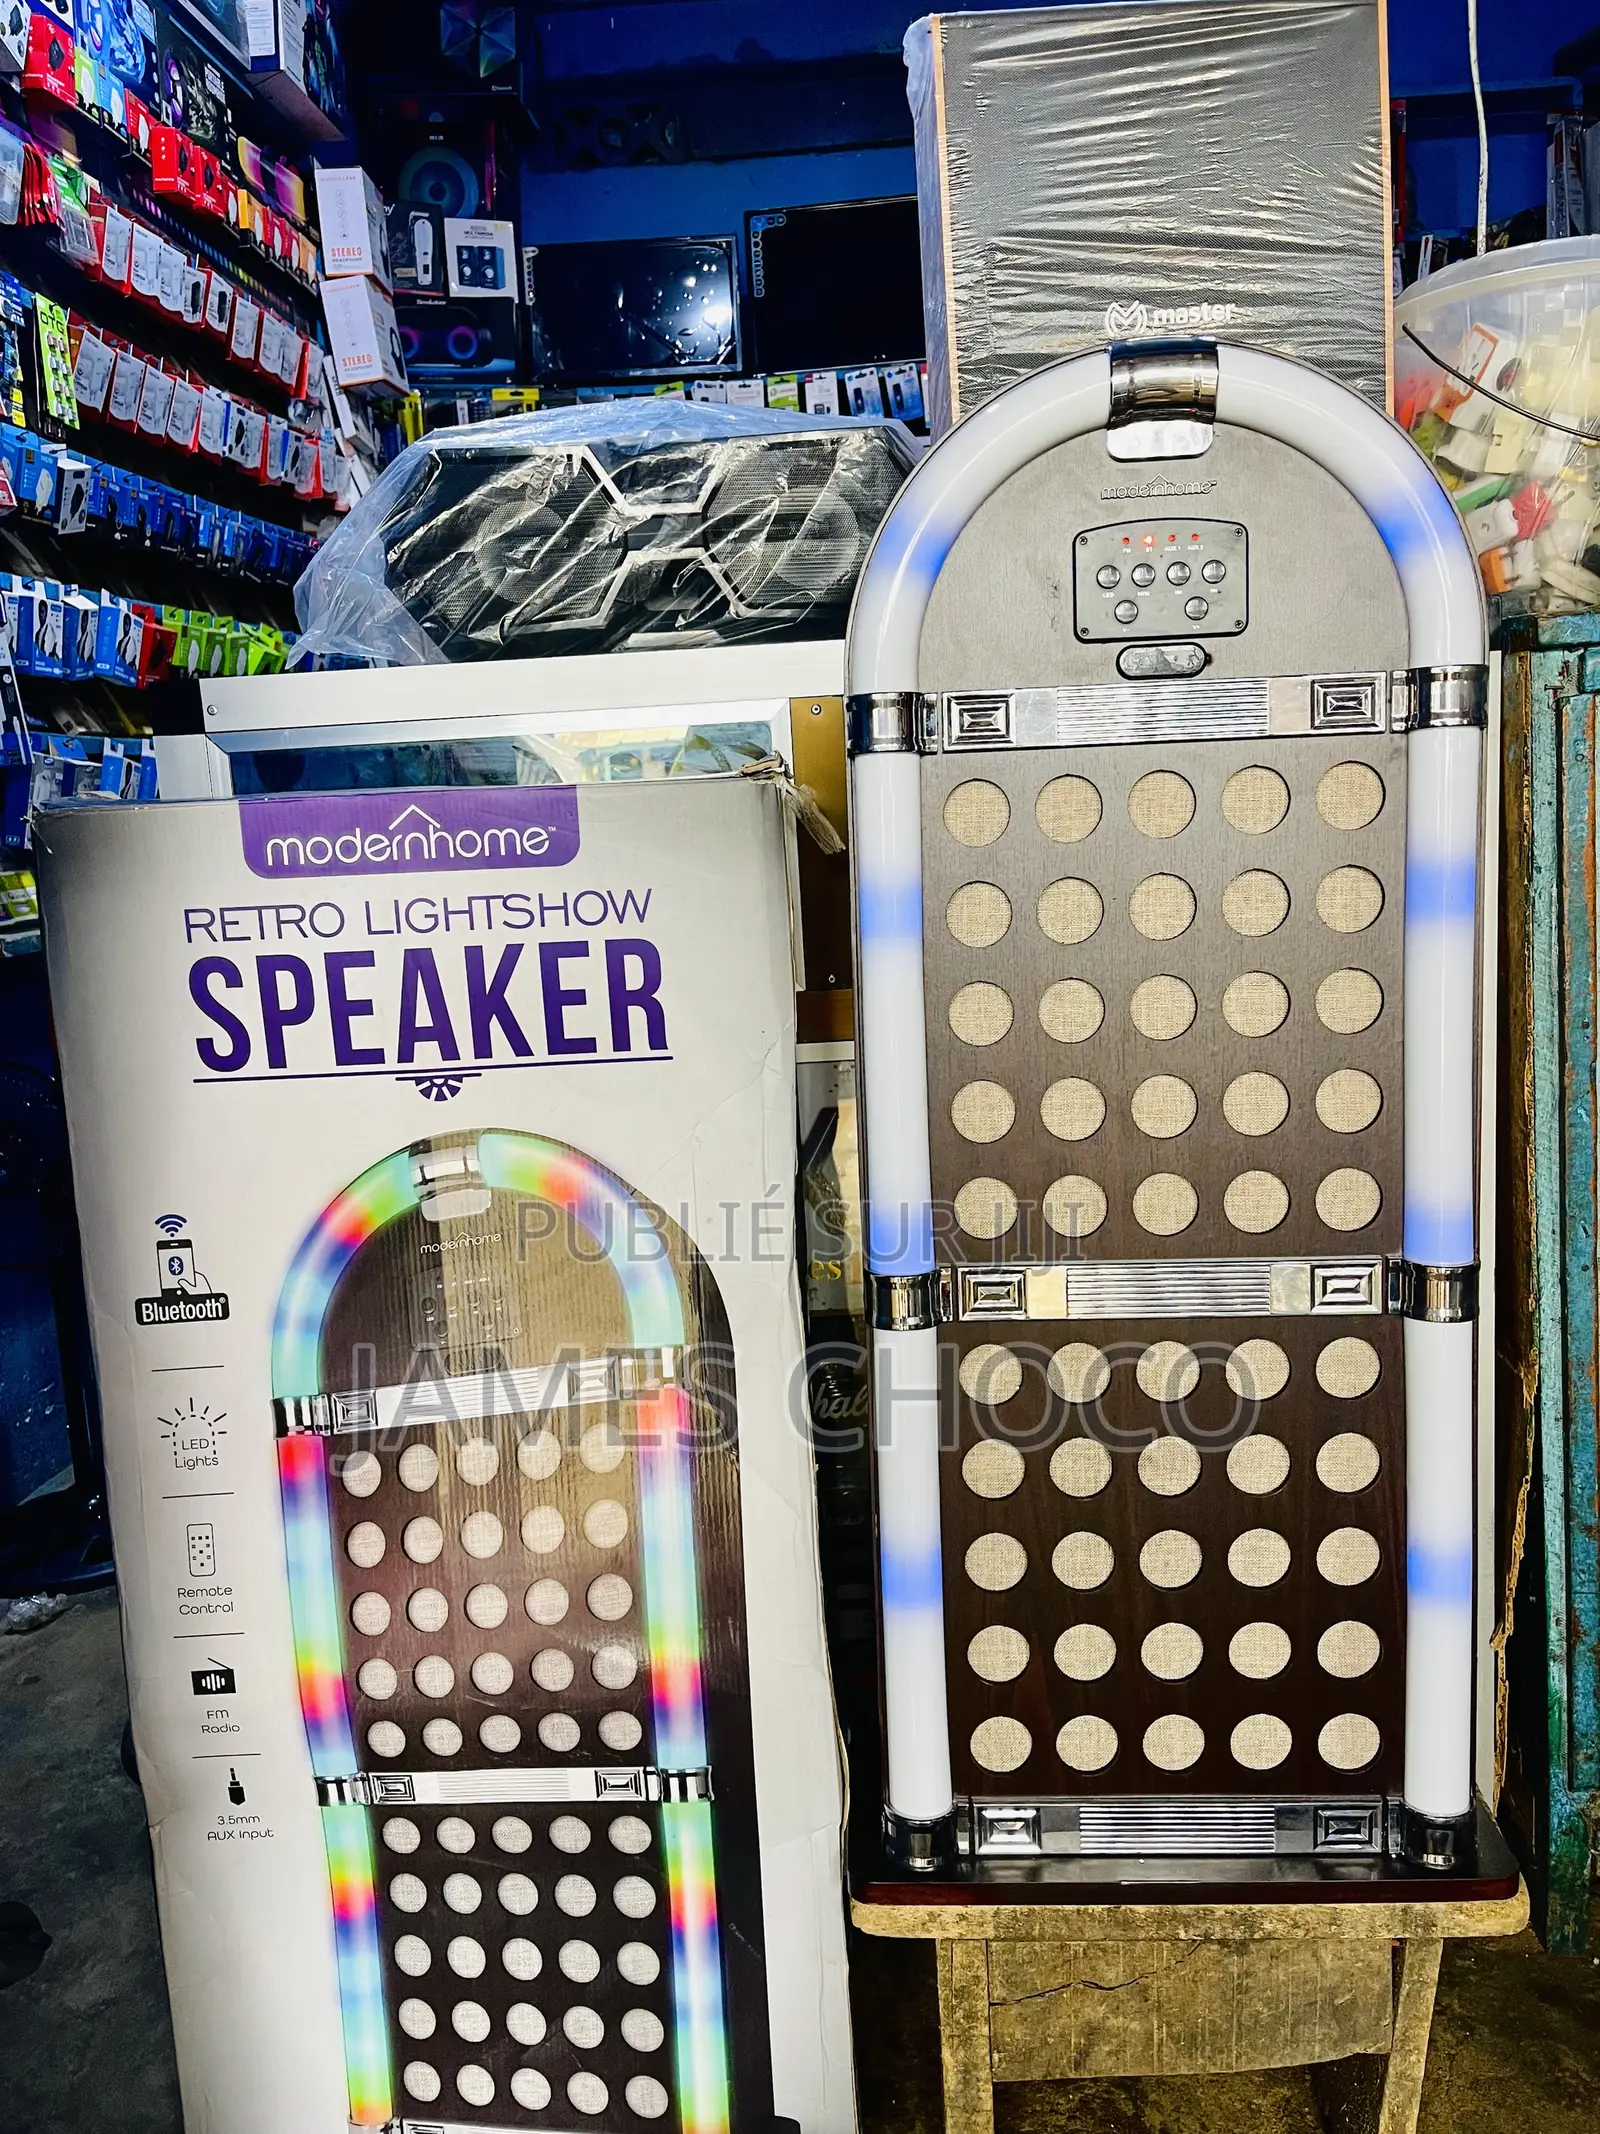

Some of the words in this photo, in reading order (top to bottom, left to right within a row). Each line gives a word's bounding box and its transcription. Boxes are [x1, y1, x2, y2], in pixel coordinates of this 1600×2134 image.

[331, 246, 362, 258] STEREO
[1153, 302, 1236, 327] master
[39, 310, 65, 335] OTG
[342, 353, 373, 368] STEREO
[184, 901, 345, 944] RETRO
[365, 888, 653, 936] LIGHTSHOW
[188, 937, 668, 1073] SPEAKER
[420, 1231, 502, 1255] modernhome
[181, 1438, 210, 1451] LED
[174, 1455, 219, 1471] Lights
[177, 1585, 233, 1599] Remote
[178, 1601, 235, 1615] Control
[206, 1709, 230, 1720] FM
[200, 1723, 241, 1735] Radio
[217, 1814, 261, 1825] 3.5mm
[207, 1829, 237, 1842] AUX
[238, 1828, 275, 1841] Input
